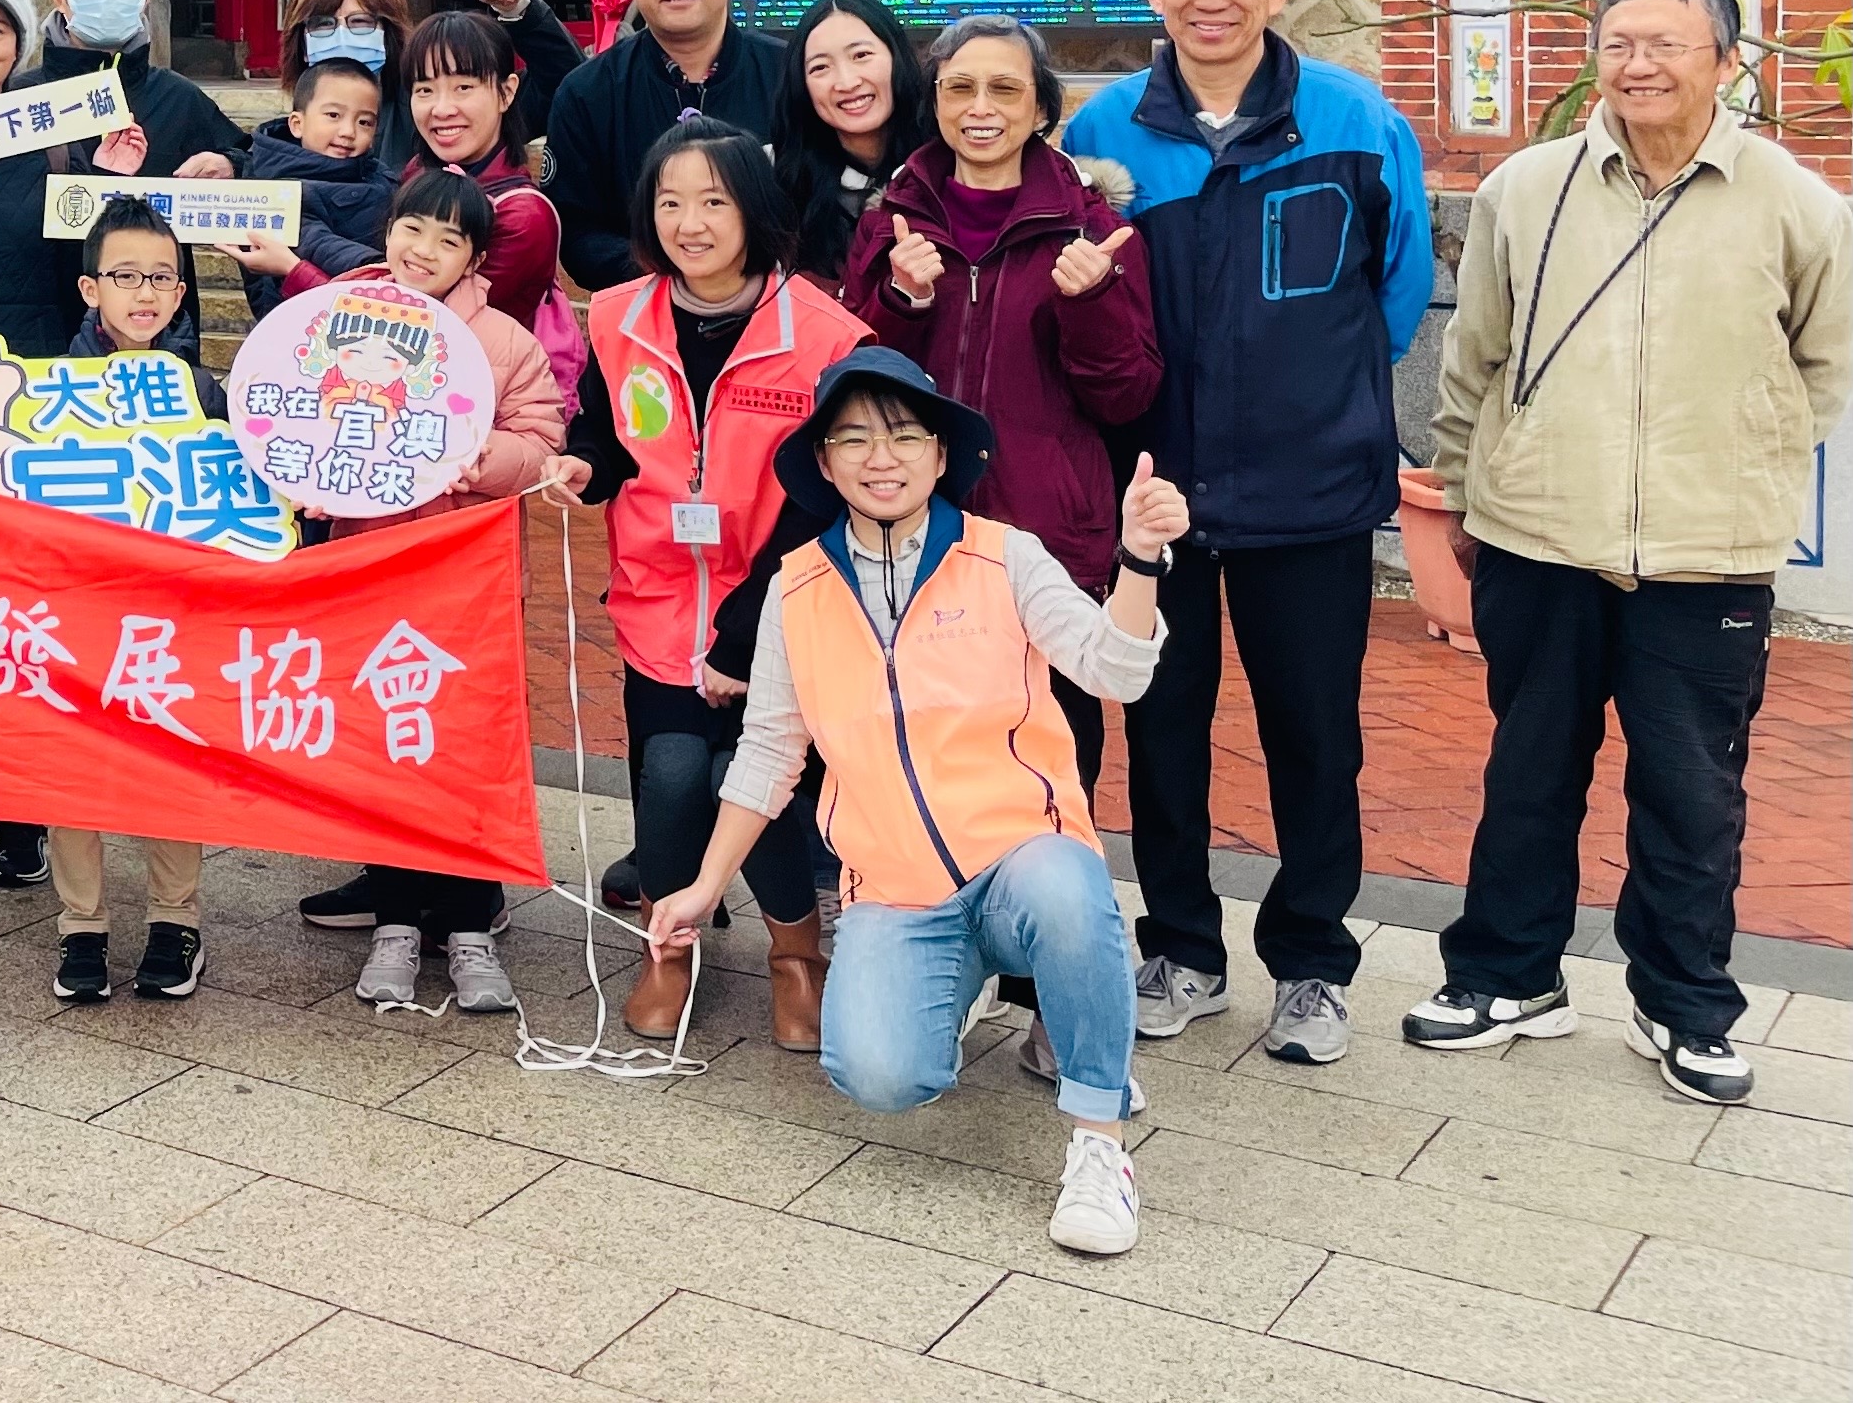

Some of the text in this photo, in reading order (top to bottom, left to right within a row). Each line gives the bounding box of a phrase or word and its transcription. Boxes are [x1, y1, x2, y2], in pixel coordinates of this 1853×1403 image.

[179, 212, 285, 229] 社區發展協會
[180, 194, 269, 204] KINMEN GUANAO
[32, 360, 189, 427] 大推
[246, 382, 447, 463] 我在官澳
[12, 431, 283, 543] 官澳
[264, 436, 415, 507] 等你來
